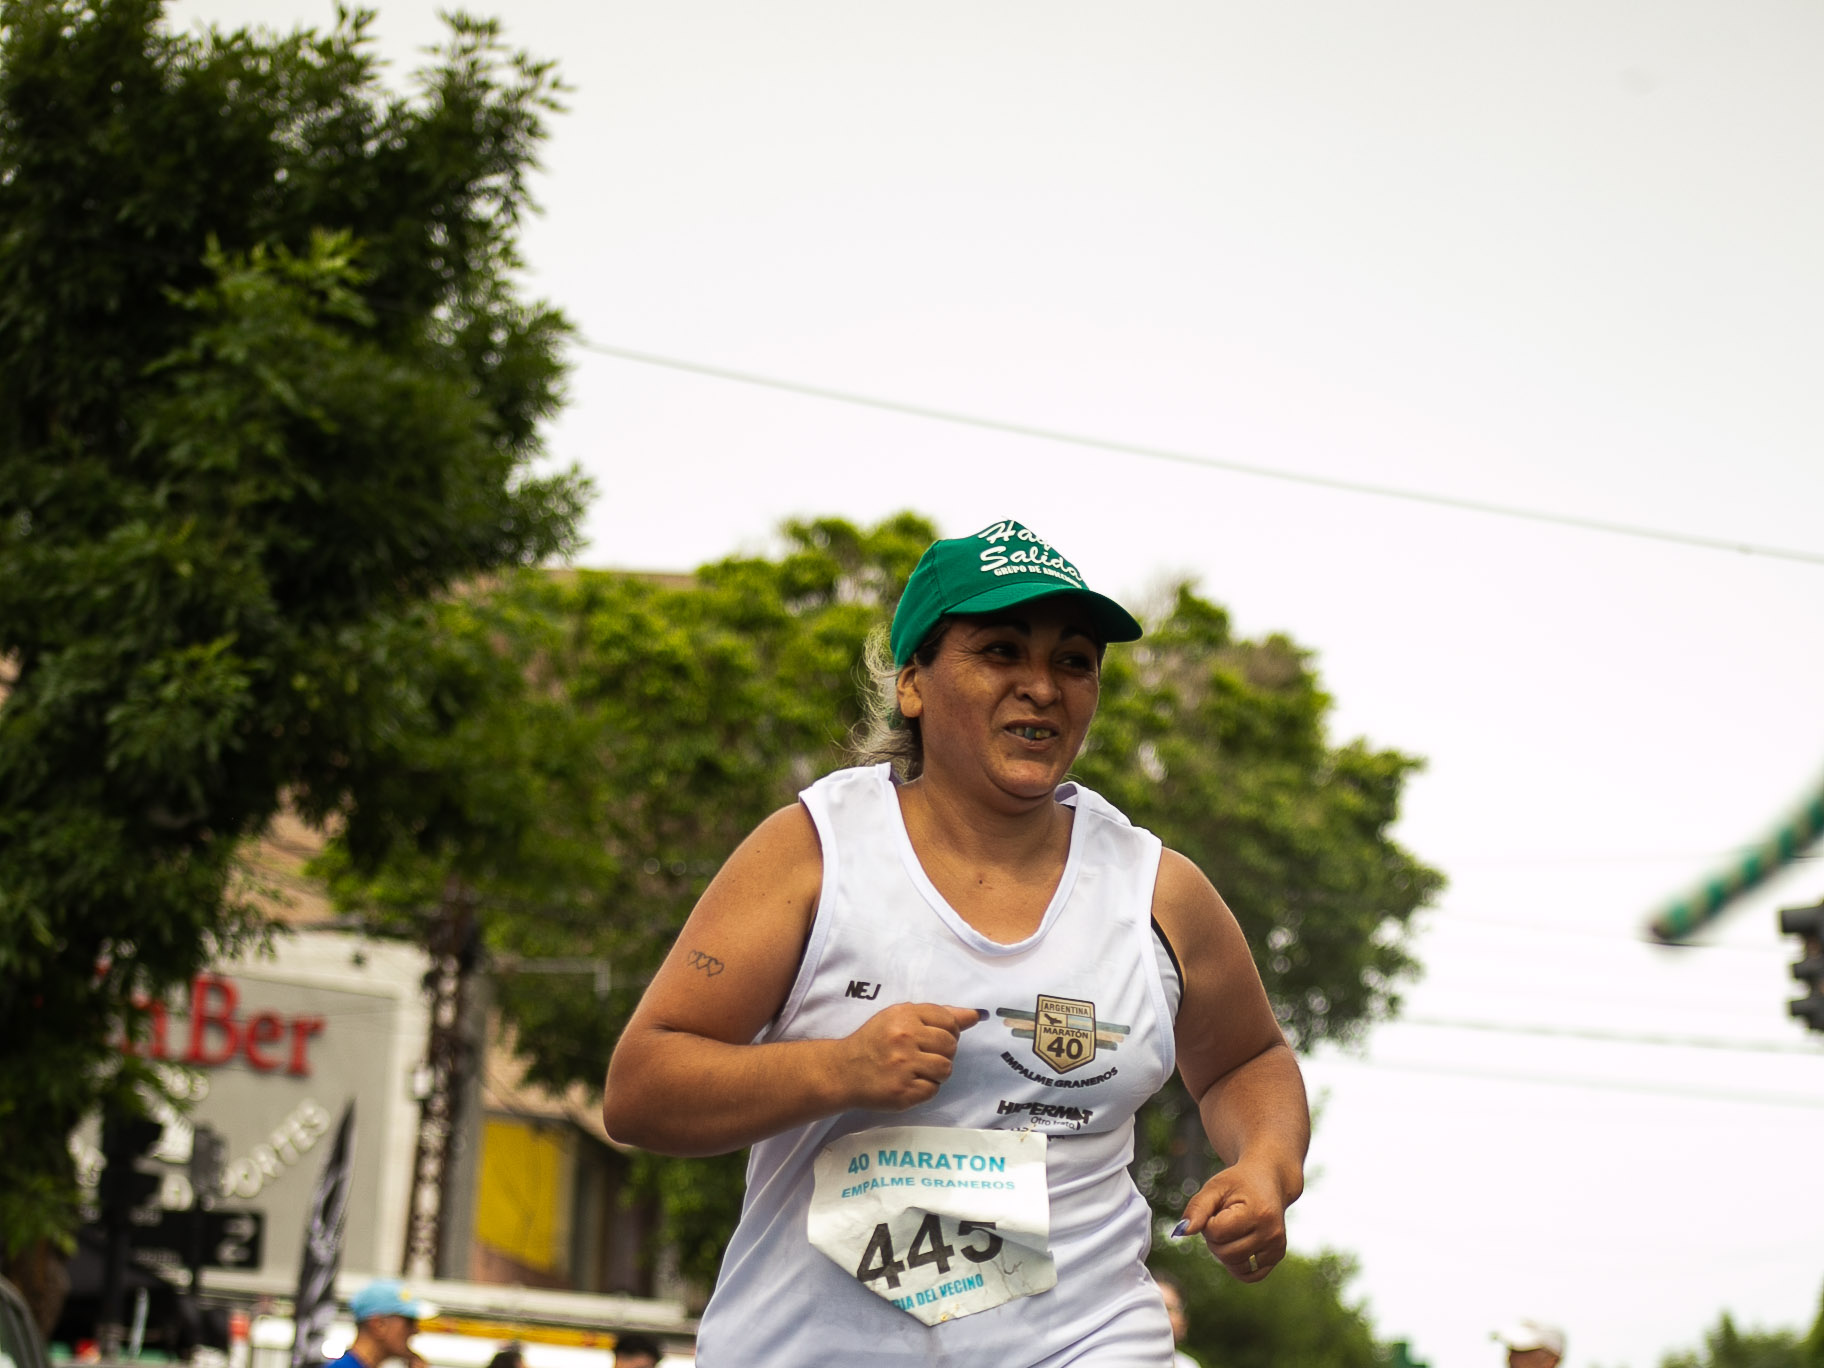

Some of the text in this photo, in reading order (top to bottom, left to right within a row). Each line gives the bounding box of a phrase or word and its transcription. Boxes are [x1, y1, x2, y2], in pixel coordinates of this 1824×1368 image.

[980, 546, 1082, 581] Salida
[844, 980, 881, 1000] NEJ
[1044, 1002, 1088, 1015] ARGENTINA
[1047, 1036, 1083, 1060] 40
[1000, 1051, 1118, 1088] EMPALME GRANEROS
[1030, 1116, 1051, 1126] Otro
[848, 1150, 1005, 1174] 40 MARATON
[841, 1177, 1016, 1198] EMPALME GRANEROS
[856, 1213, 1005, 1289] 445
[916, 1287, 938, 1306] DEL
[938, 1273, 984, 1297] VECINO
